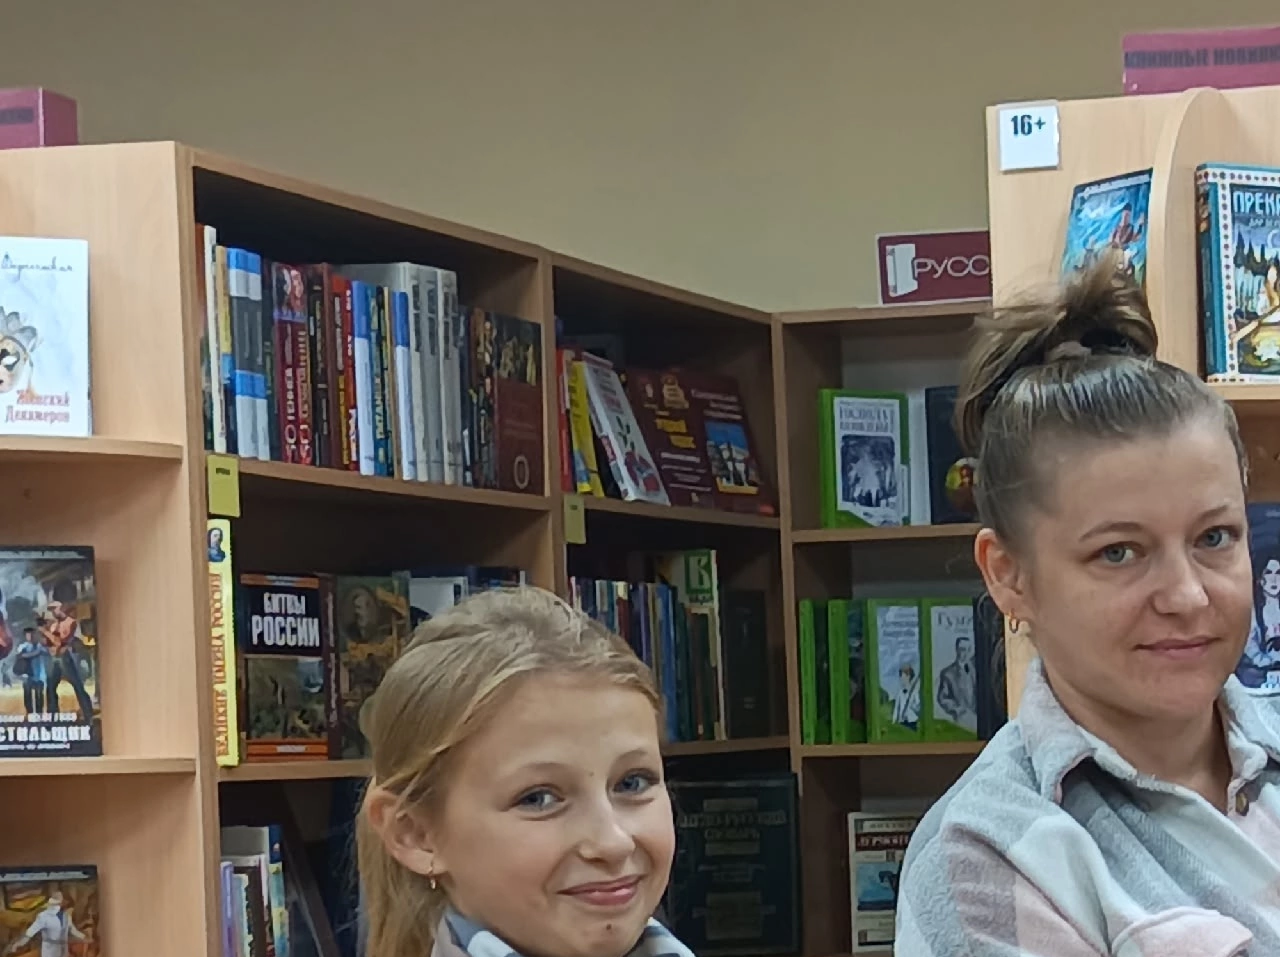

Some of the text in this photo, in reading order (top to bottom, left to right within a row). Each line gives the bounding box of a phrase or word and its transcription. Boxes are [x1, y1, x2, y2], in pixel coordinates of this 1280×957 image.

[1010, 115, 1046, 136] 16+
[263, 592, 306, 615] БИТВЫ
[251, 614, 320, 648] РОССИИ
